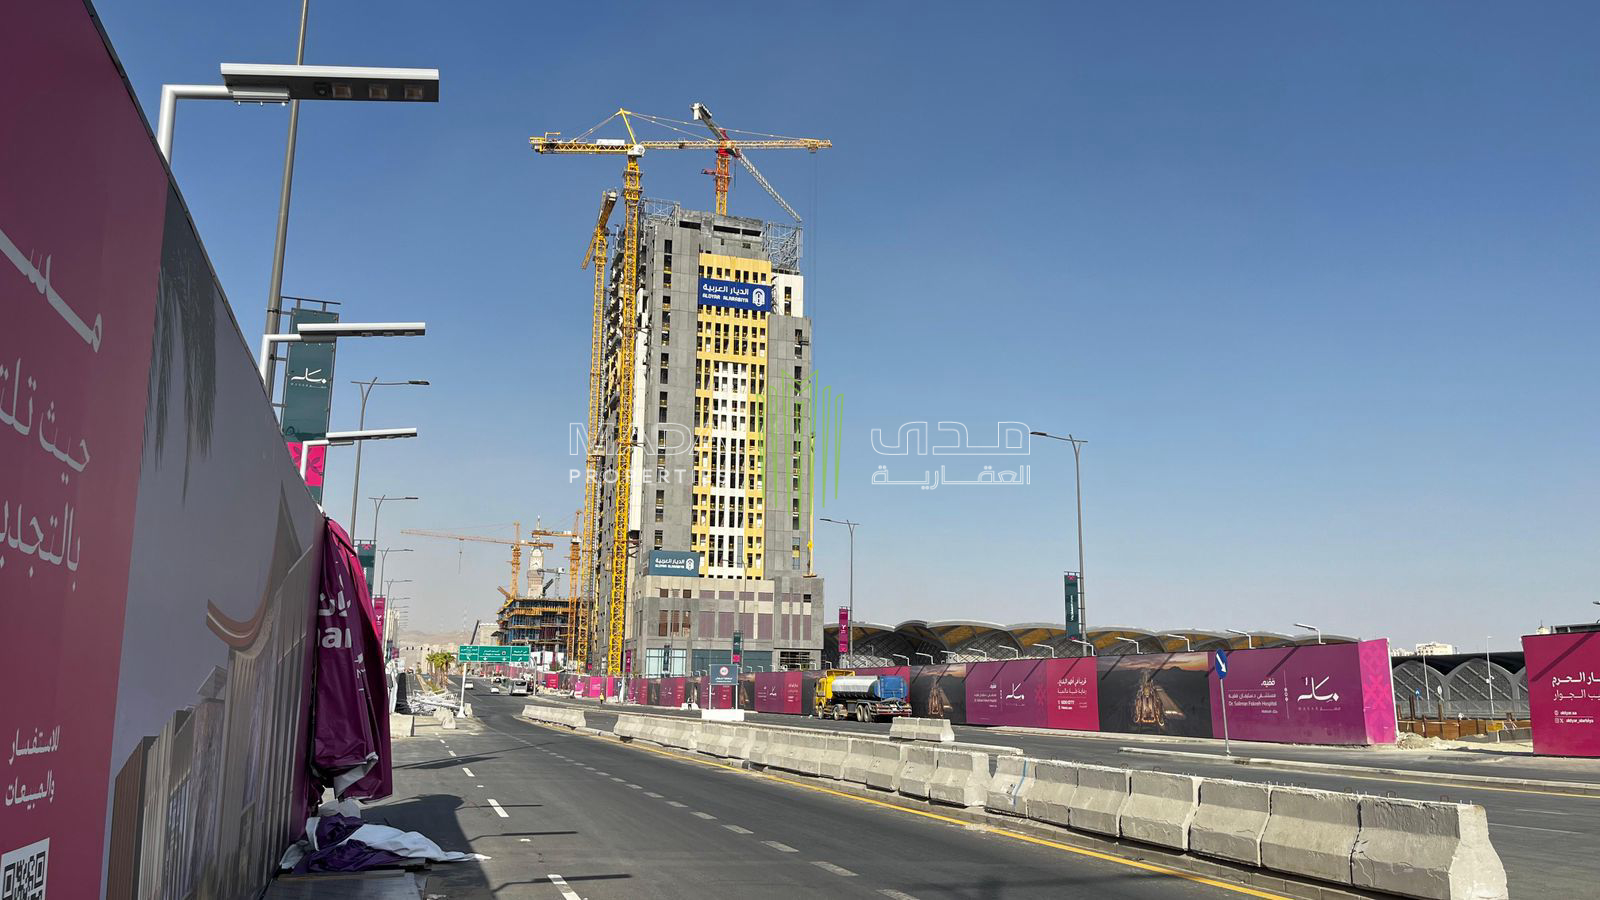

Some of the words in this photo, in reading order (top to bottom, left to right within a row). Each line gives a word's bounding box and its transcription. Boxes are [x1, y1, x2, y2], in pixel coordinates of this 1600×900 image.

[702, 283, 729, 293] العربية
[730, 286, 749, 296] الديار
[39, 400, 90, 486] حيث
[0, 500, 81, 593] بالتجدي
[1552, 672, 1585, 688] الحرم
[1553, 689, 1586, 701] الجوار
[5, 768, 55, 811] والمبيعات
